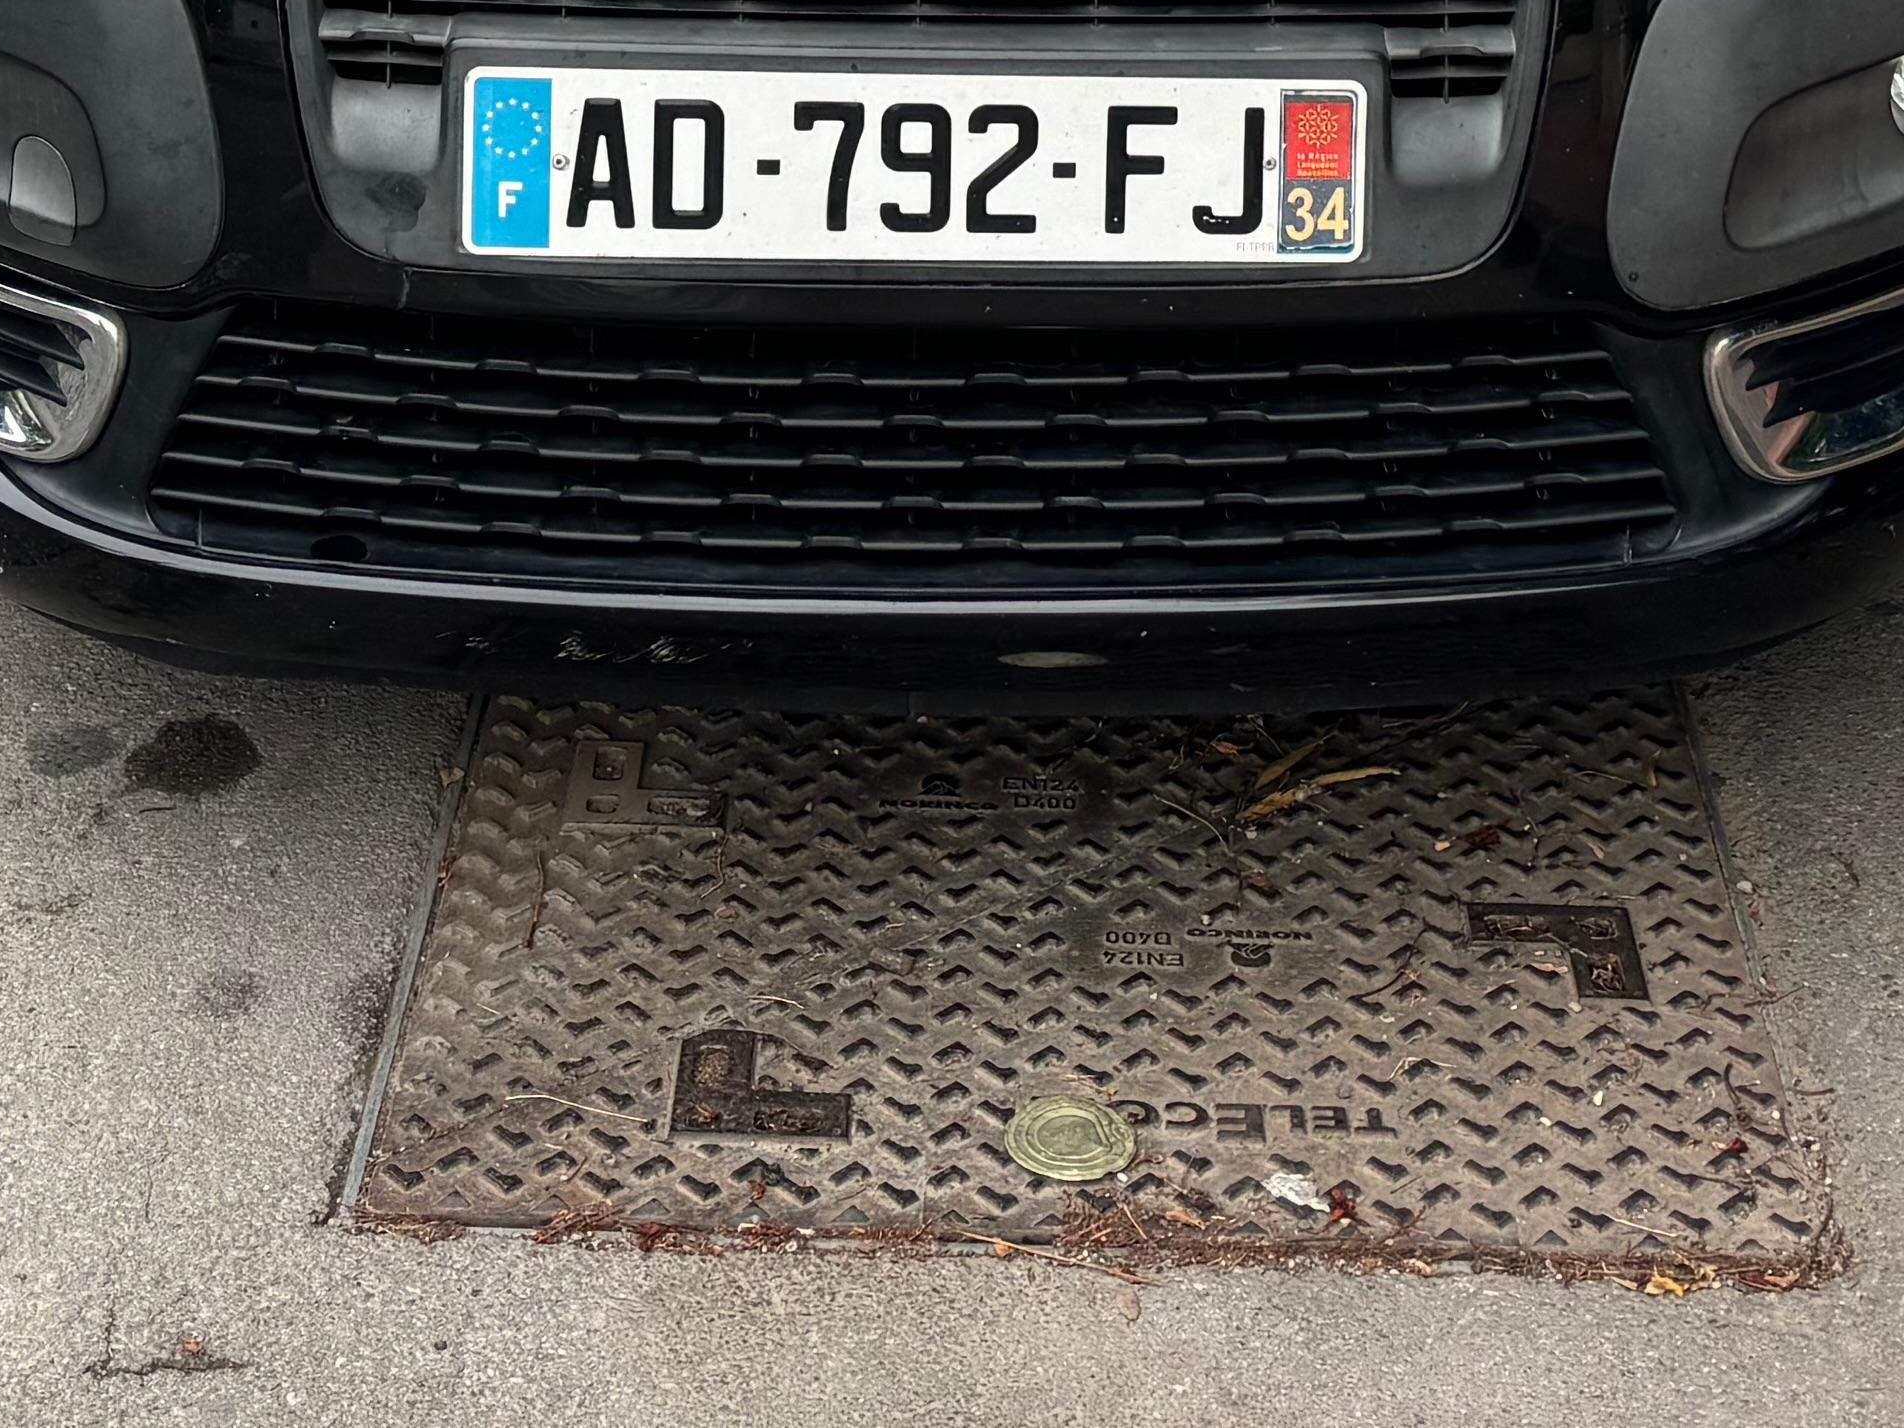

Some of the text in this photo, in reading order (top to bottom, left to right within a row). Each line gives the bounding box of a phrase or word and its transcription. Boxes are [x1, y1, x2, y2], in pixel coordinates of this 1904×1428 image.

[566, 97, 1265, 235] AD-792-FJ
[498, 180, 523, 217] F
[1285, 187, 1349, 242] 34
[1002, 776, 1081, 793] EN124
[1014, 795, 1077, 811] D400
[1105, 930, 1171, 945] D400
[1185, 927, 1313, 941] NORINCO
[1103, 950, 1184, 967] EN124
[1106, 1100, 1397, 1143] TELECO
